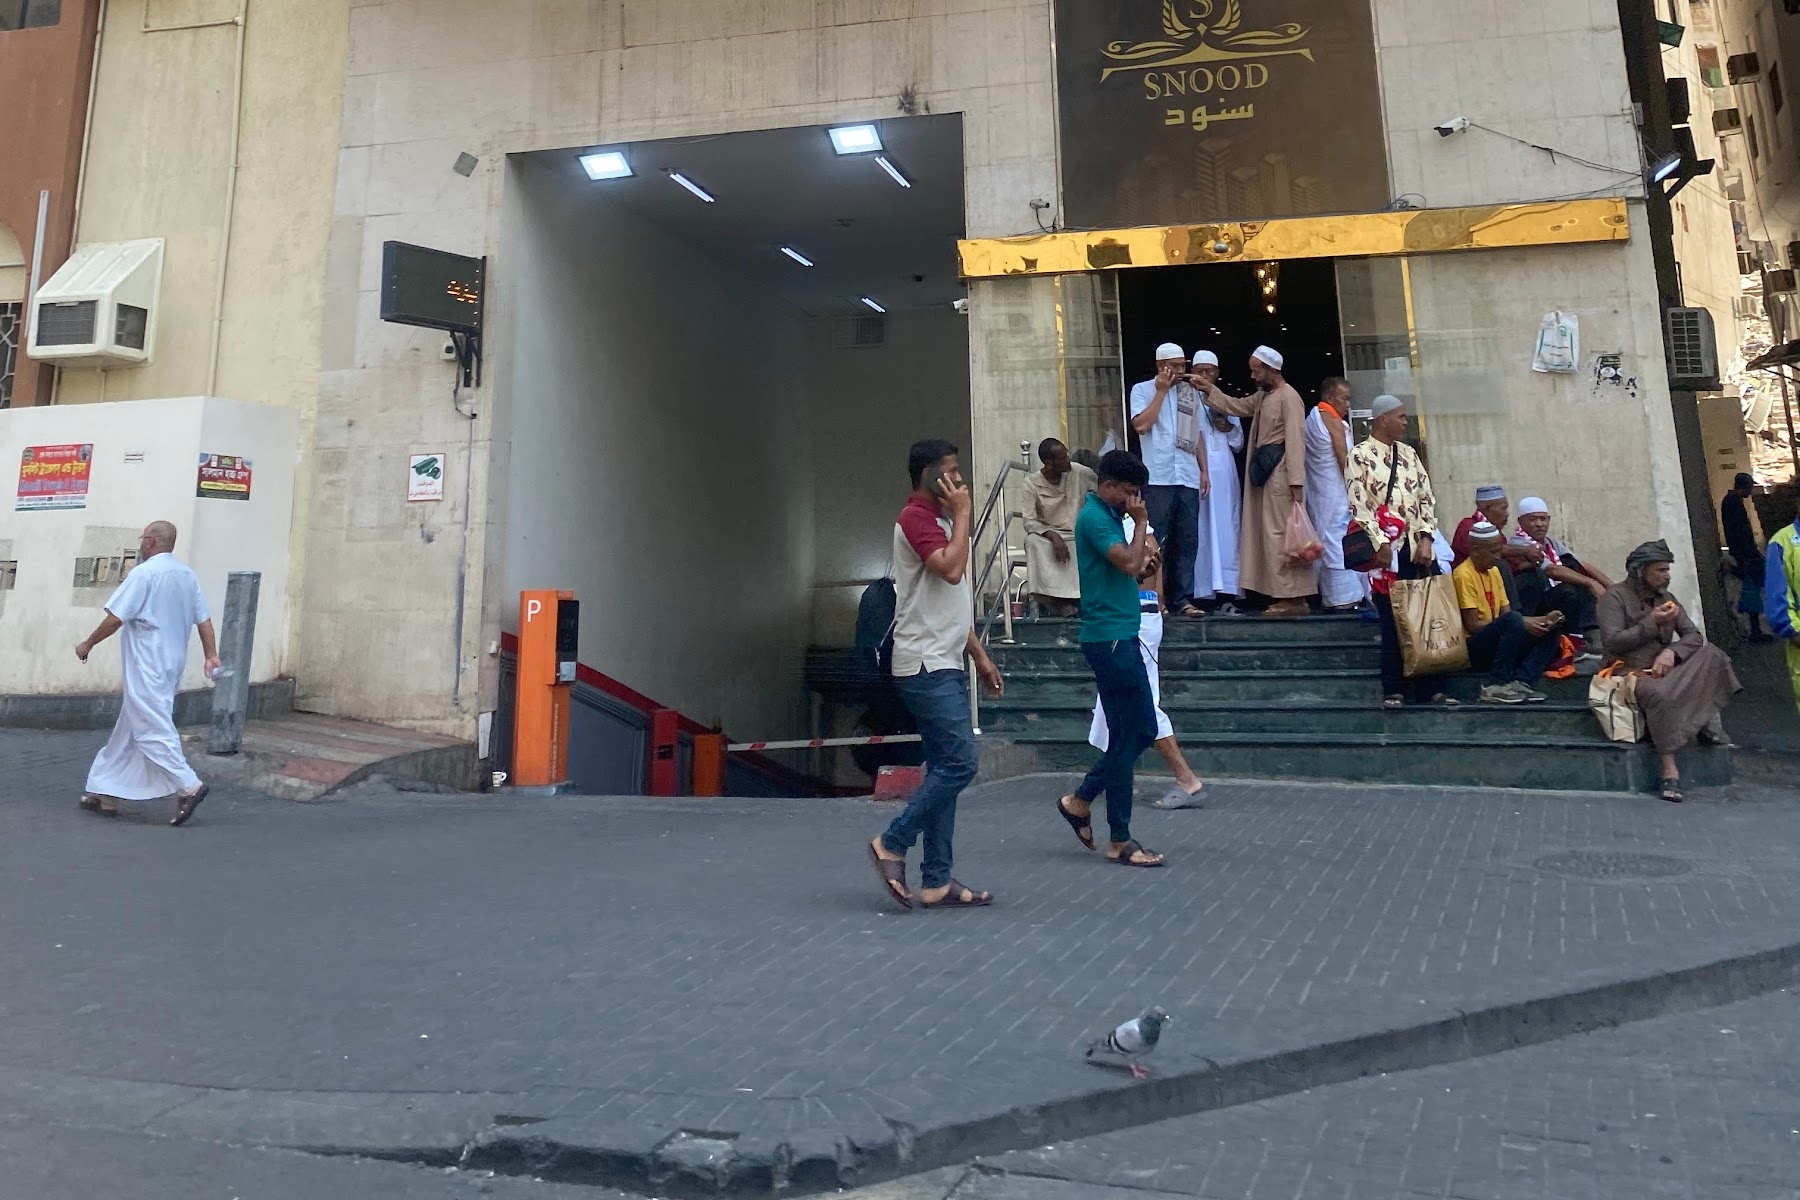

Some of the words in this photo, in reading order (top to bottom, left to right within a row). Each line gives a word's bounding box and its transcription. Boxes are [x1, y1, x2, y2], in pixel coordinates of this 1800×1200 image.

[1143, 63, 1269, 100] SNOOD
[1164, 97, 1254, 132] سنود
[527, 599, 542, 623] P
